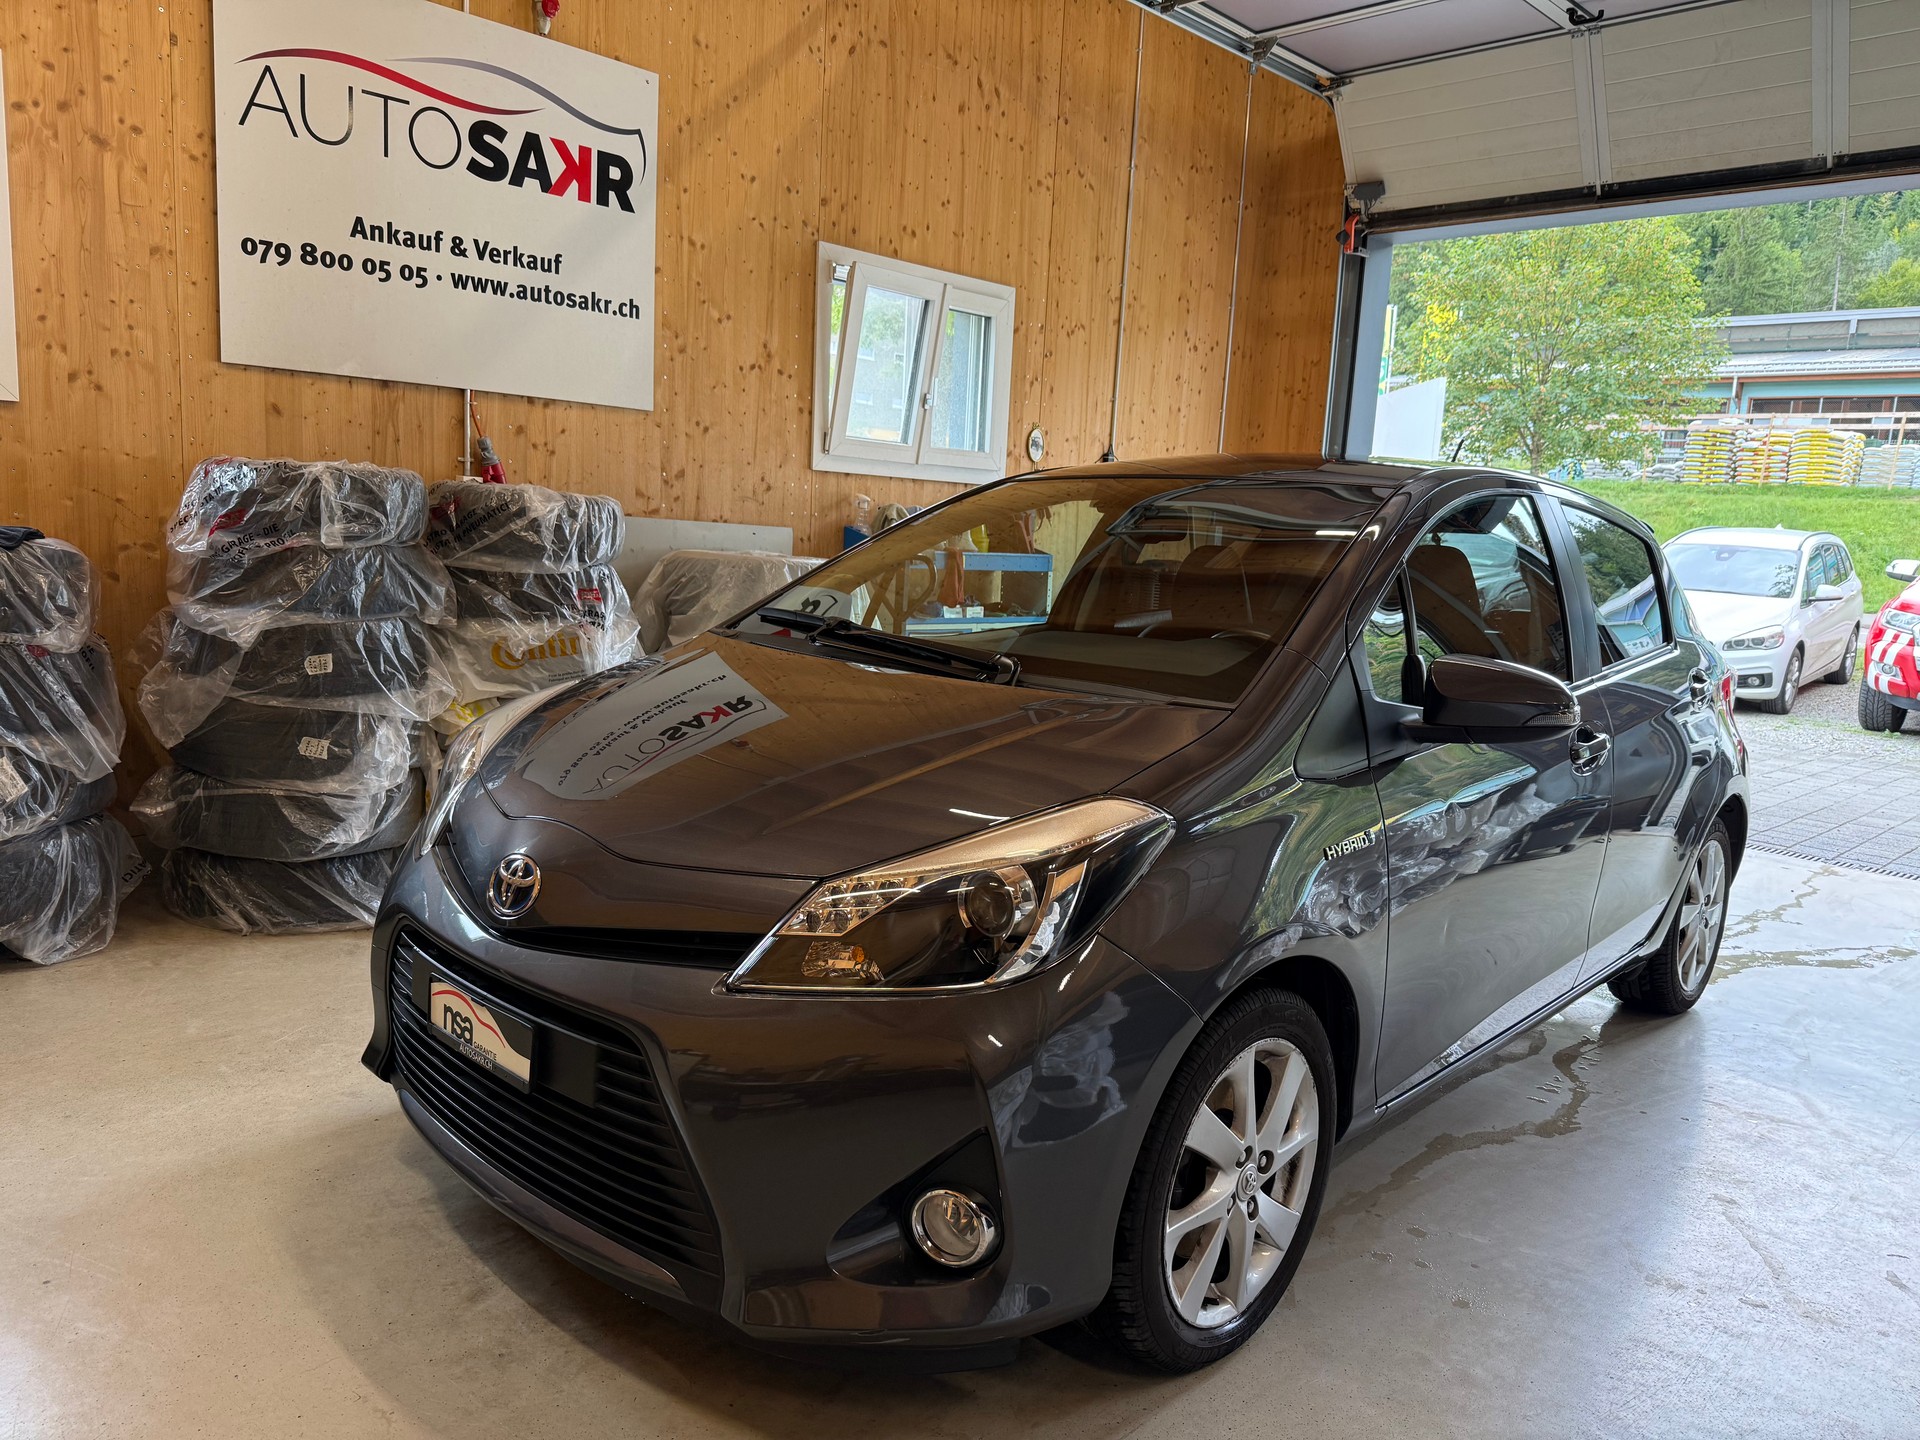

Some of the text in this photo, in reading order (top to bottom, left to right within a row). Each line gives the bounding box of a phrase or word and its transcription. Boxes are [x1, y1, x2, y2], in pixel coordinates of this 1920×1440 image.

[350, 216, 563, 275] Ankauf & Verkauf
[240, 236, 291, 266] 079
[300, 243, 353, 272] 800
[362, 259, 391, 282] 05
[399, 263, 428, 288] 05
[450, 271, 641, 320] www.autosakr.ch
[262, 523, 280, 536] DIE
[1323, 833, 1371, 860] HYBRID
[444, 1004, 474, 1047] nsa
[459, 1043, 493, 1071] AUTOSAKR.CH
[473, 1041, 497, 1061] GARANTIE
